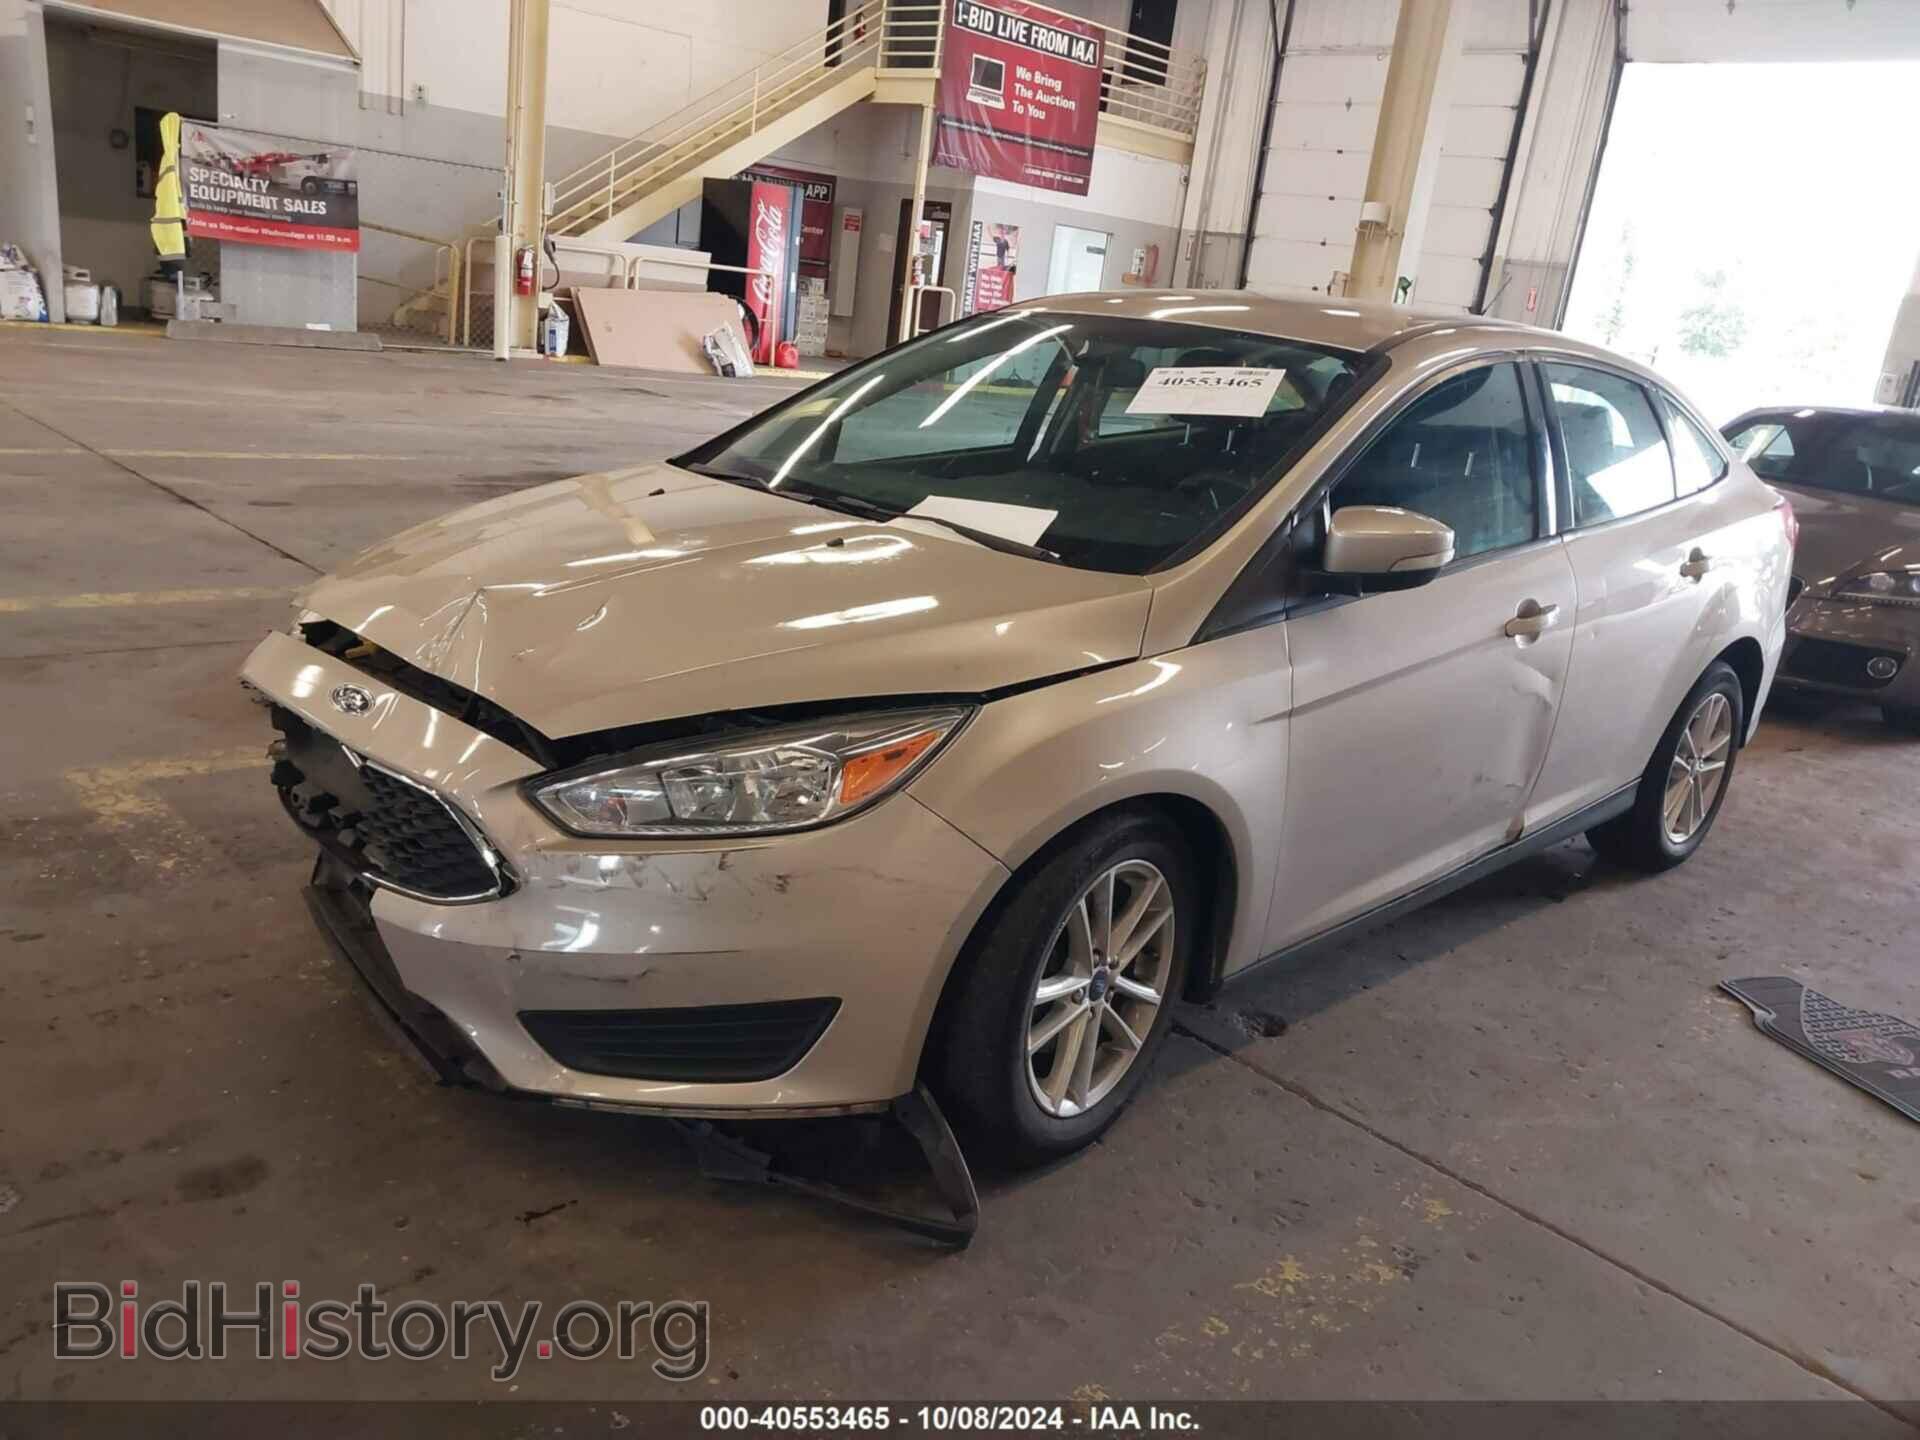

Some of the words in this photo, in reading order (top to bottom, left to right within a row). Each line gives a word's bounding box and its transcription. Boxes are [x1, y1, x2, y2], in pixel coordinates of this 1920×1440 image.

[958, 2, 994, 32] I-BID
[998, 14, 1029, 43] LIVE
[1031, 24, 1069, 55] FROM
[1071, 38, 1095, 63] IAA
[1016, 64, 1032, 82] We
[1034, 70, 1062, 92] Bring
[1012, 100, 1024, 114] To
[1027, 103, 1046, 119] You
[1014, 82, 1033, 99] The
[1035, 89, 1076, 111] Auction
[189, 166, 270, 194] SPECIALTY
[806, 183, 828, 199] APP
[190, 184, 279, 211] EQUIPMENT
[283, 198, 327, 215] SALES
[969, 246, 979, 273] WITH
[1157, 377, 1265, 387] 40553465
